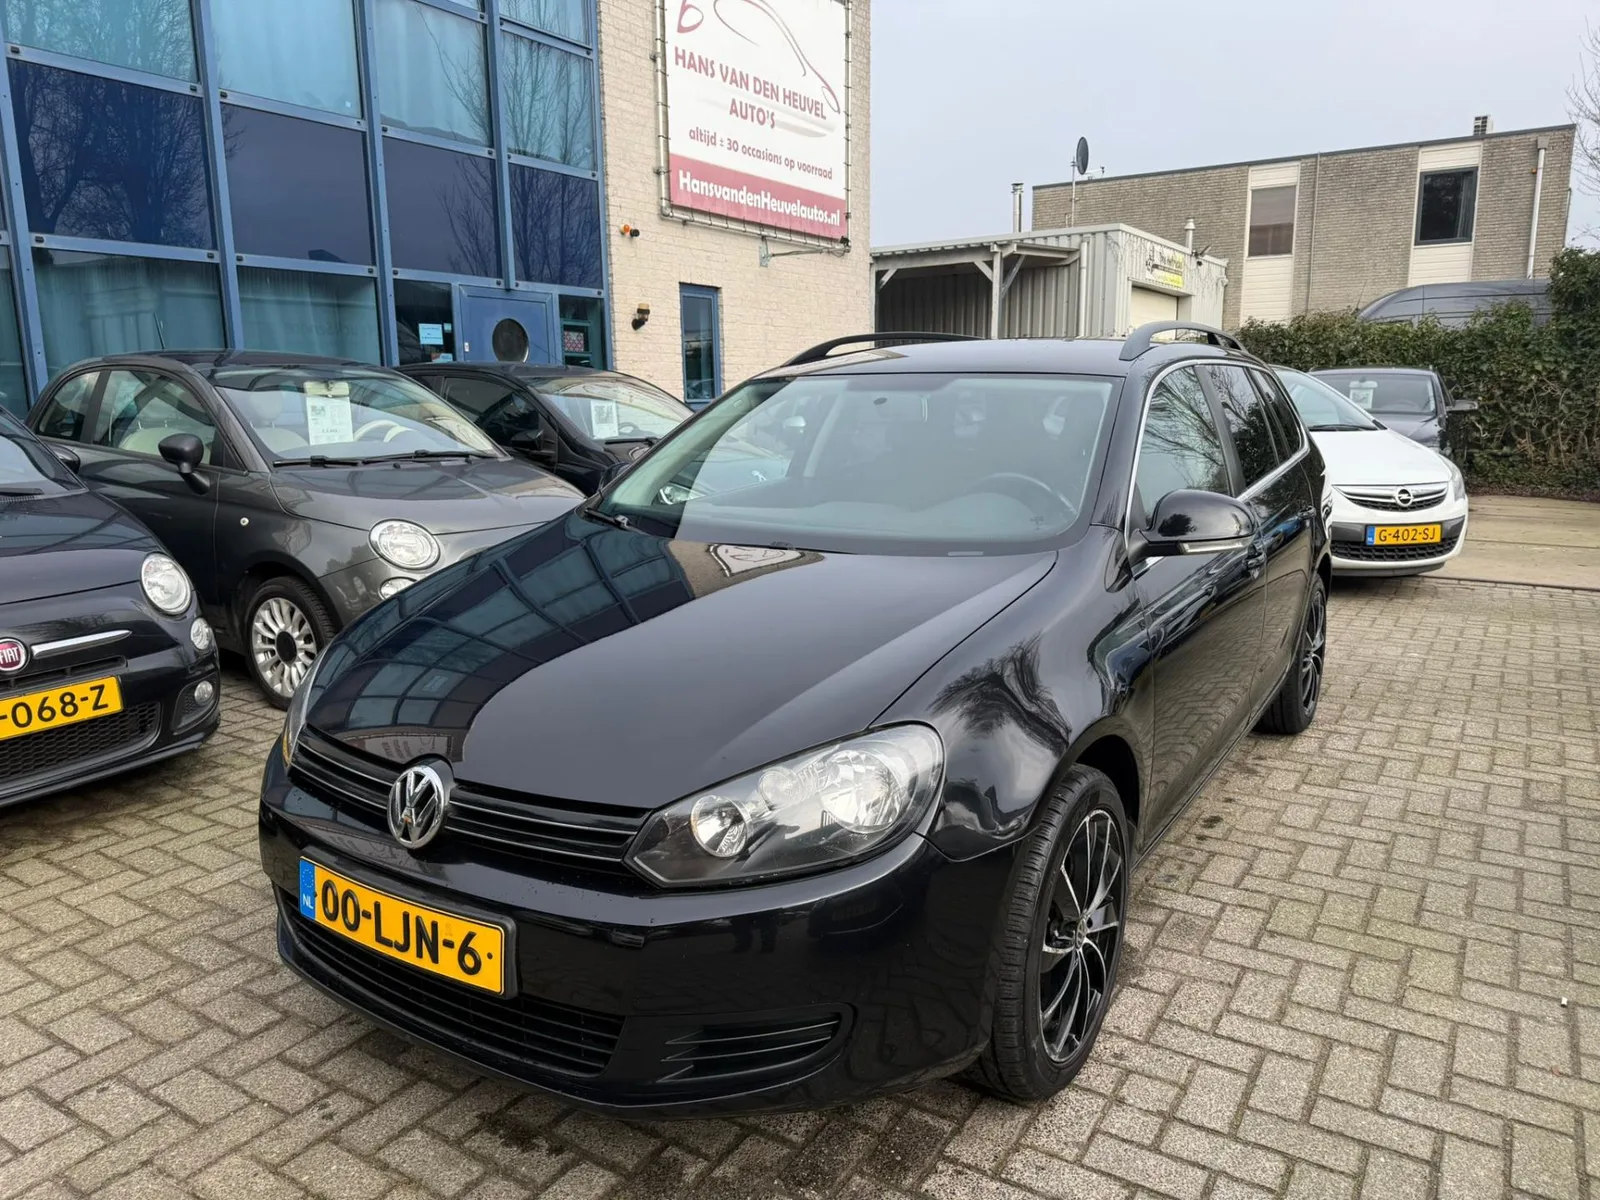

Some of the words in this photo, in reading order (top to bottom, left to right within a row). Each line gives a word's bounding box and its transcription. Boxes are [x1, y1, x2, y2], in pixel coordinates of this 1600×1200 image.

[674, 46, 715, 78] HANS
[719, 63, 749, 91] VAN
[753, 76, 779, 102] DEN
[783, 88, 826, 120] HEUVEL
[729, 98, 775, 129] AUTO'S
[689, 127, 717, 147] altijd
[727, 138, 739, 152] 30
[742, 145, 782, 165] occasions
[784, 157, 795, 171] op
[797, 161, 833, 180] voorraad
[679, 170, 840, 226] HansvandenHeuvelautos.nl
[1379, 528, 1436, 542] G-402-SJ
[302, 895, 314, 910] NL
[321, 880, 482, 976] 00-LJN-6
